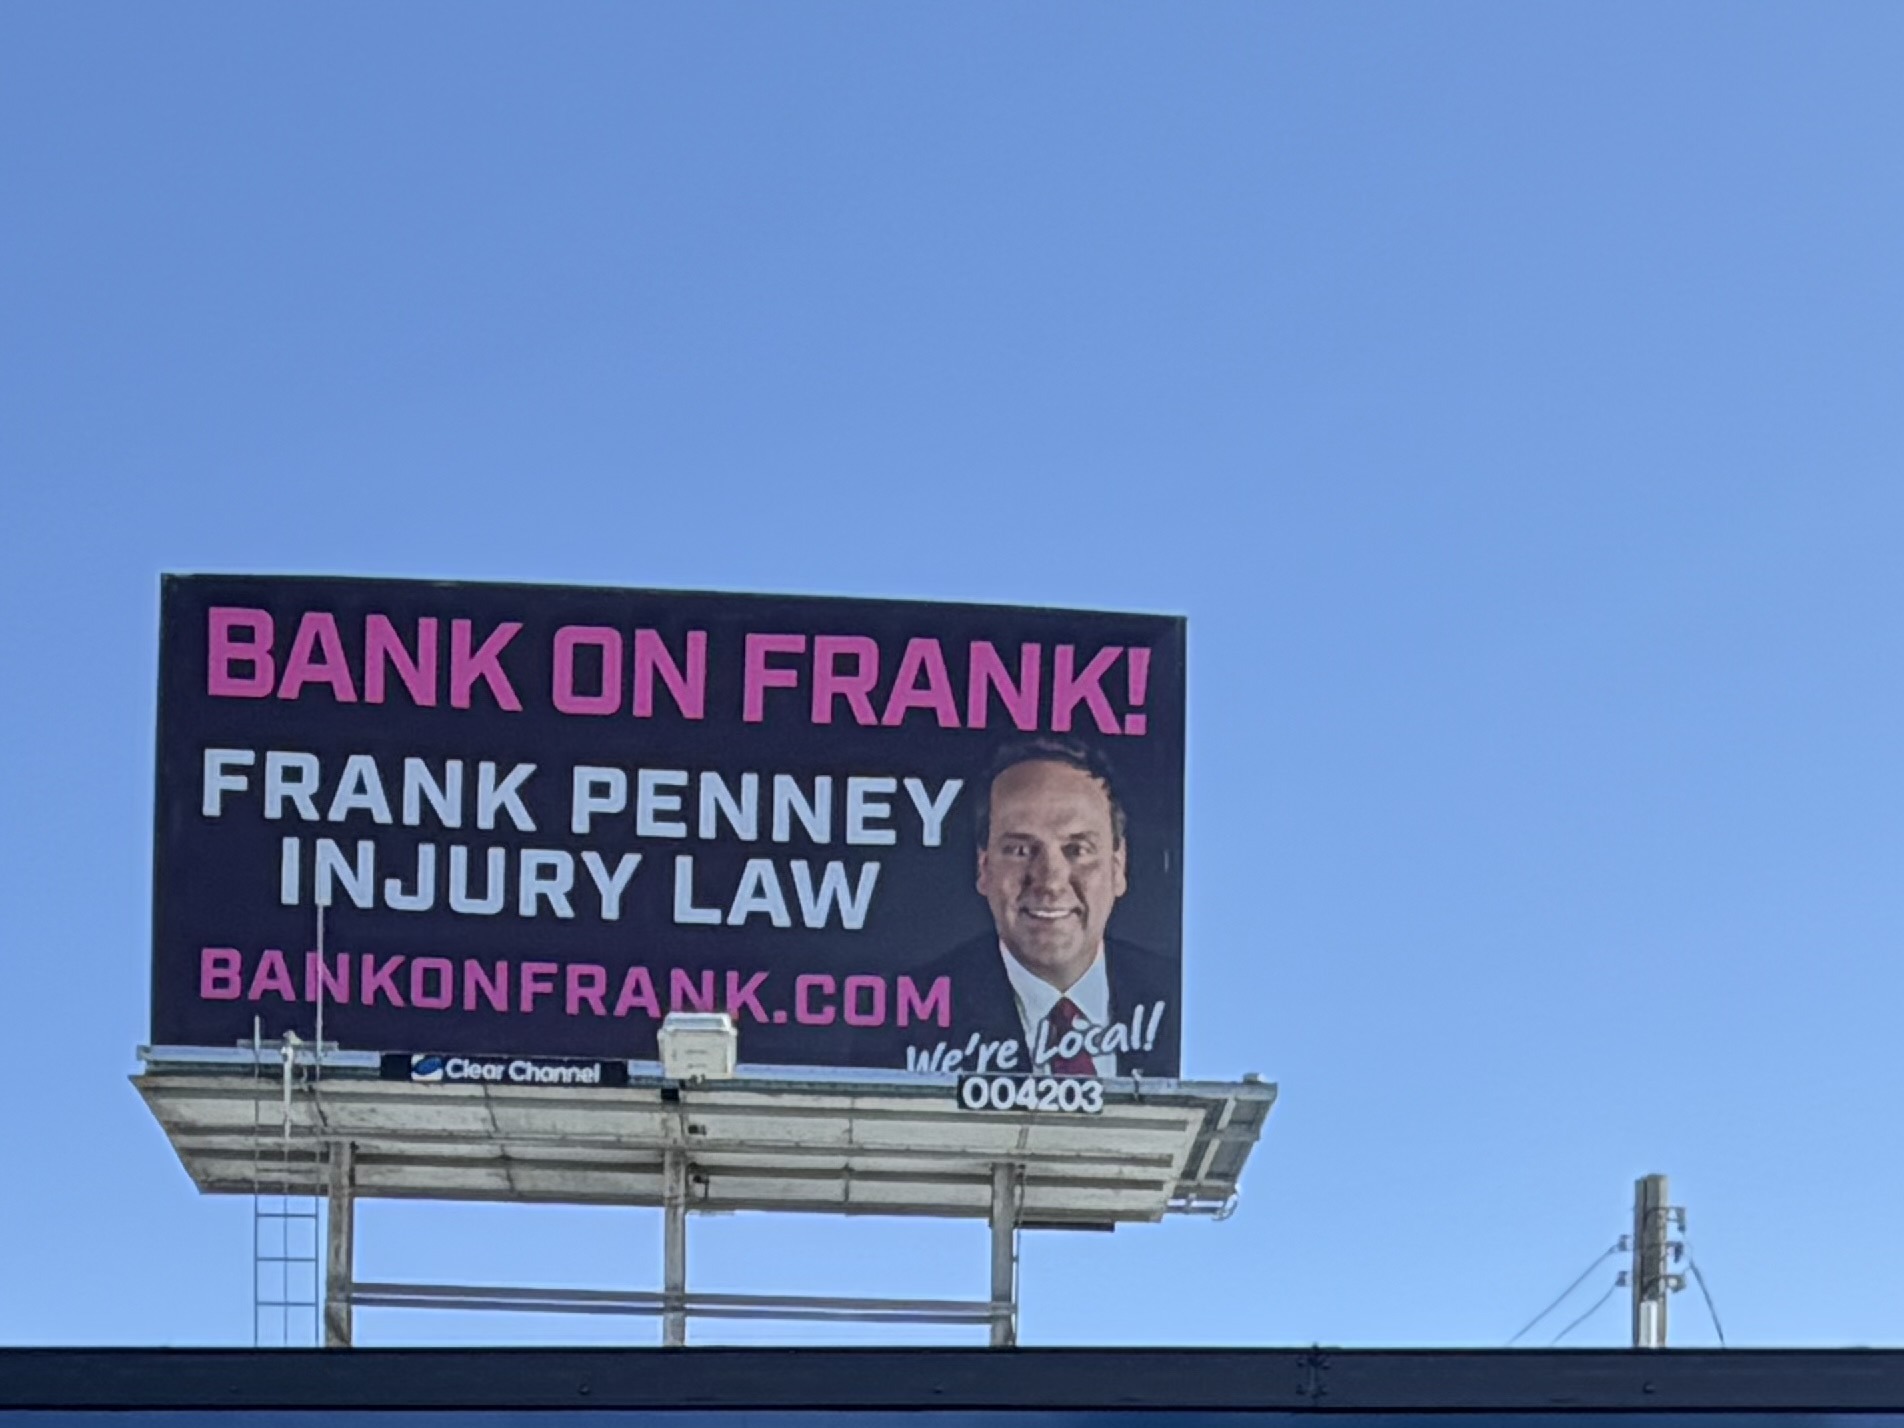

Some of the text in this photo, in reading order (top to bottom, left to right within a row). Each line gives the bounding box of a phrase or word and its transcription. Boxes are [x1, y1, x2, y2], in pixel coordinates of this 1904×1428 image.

[207, 606, 1151, 736] BANK ON FRANK!
[201, 747, 964, 848] FRANK PENNEY
[280, 836, 881, 930] INJURY LAW
[199, 946, 952, 1028] BANKONFRANK.COM
[446, 1057, 601, 1084] Clear Channel
[905, 1000, 1166, 1074] We're Local!
[961, 1076, 1105, 1113] 004203
